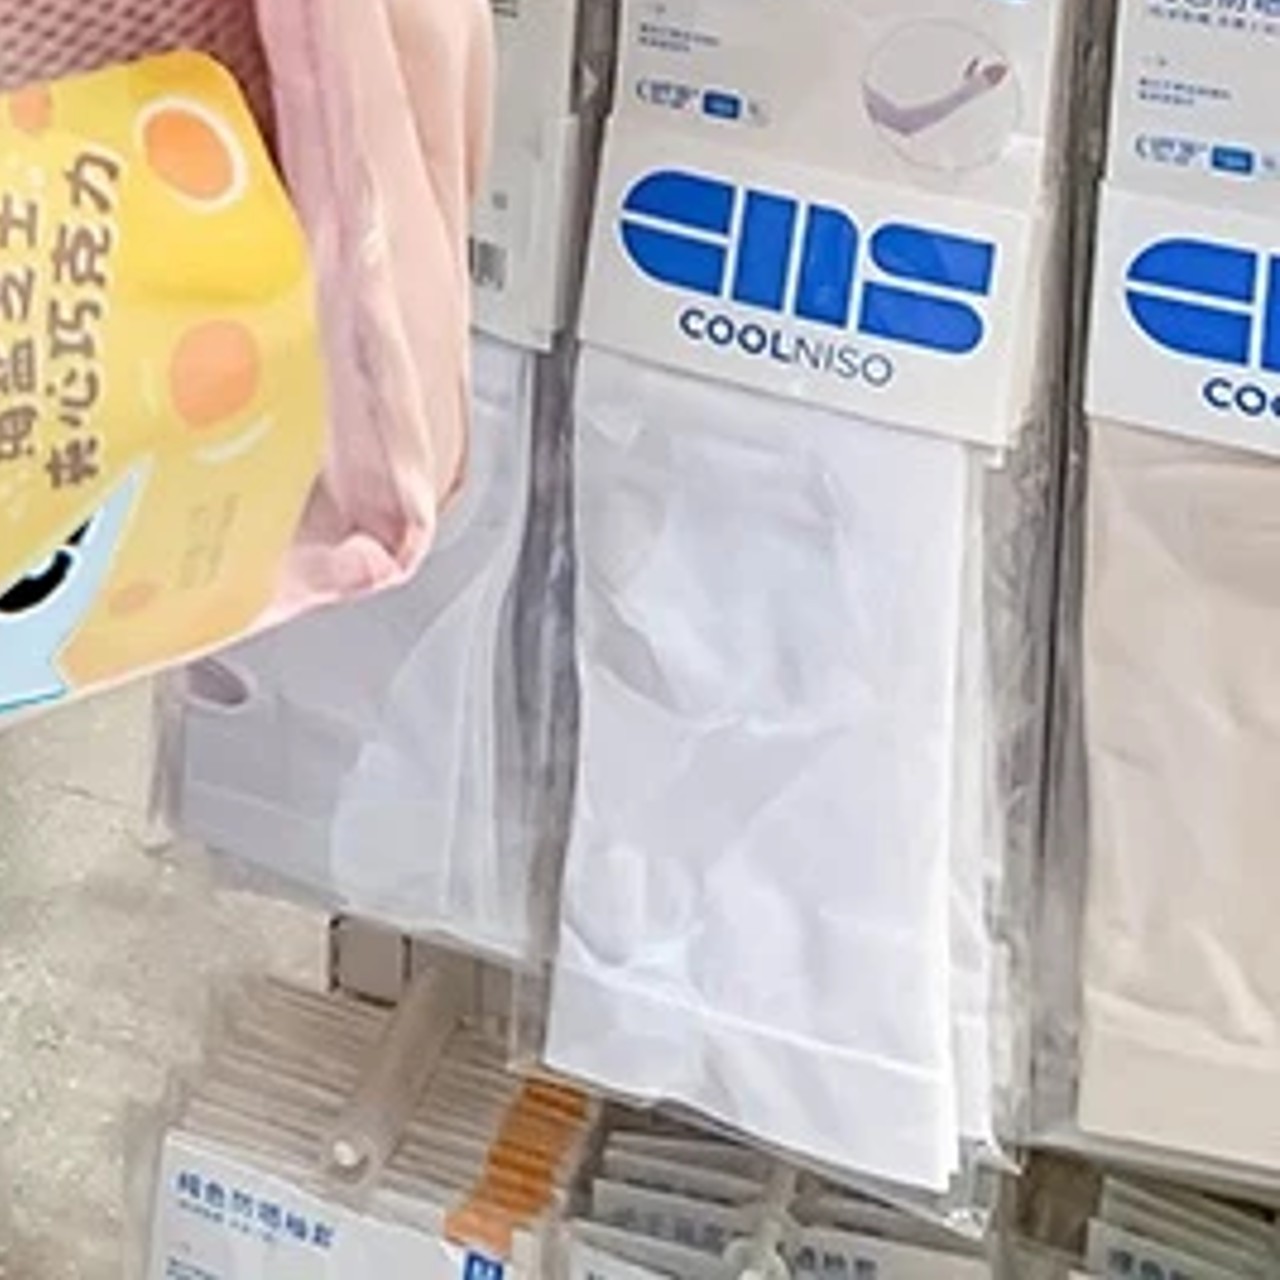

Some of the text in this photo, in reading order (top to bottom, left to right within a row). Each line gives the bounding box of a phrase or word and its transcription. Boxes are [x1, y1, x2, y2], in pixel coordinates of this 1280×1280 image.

[44, 151, 120, 490] 夹心巧克力
[678, 308, 893, 388] COOLNISO
